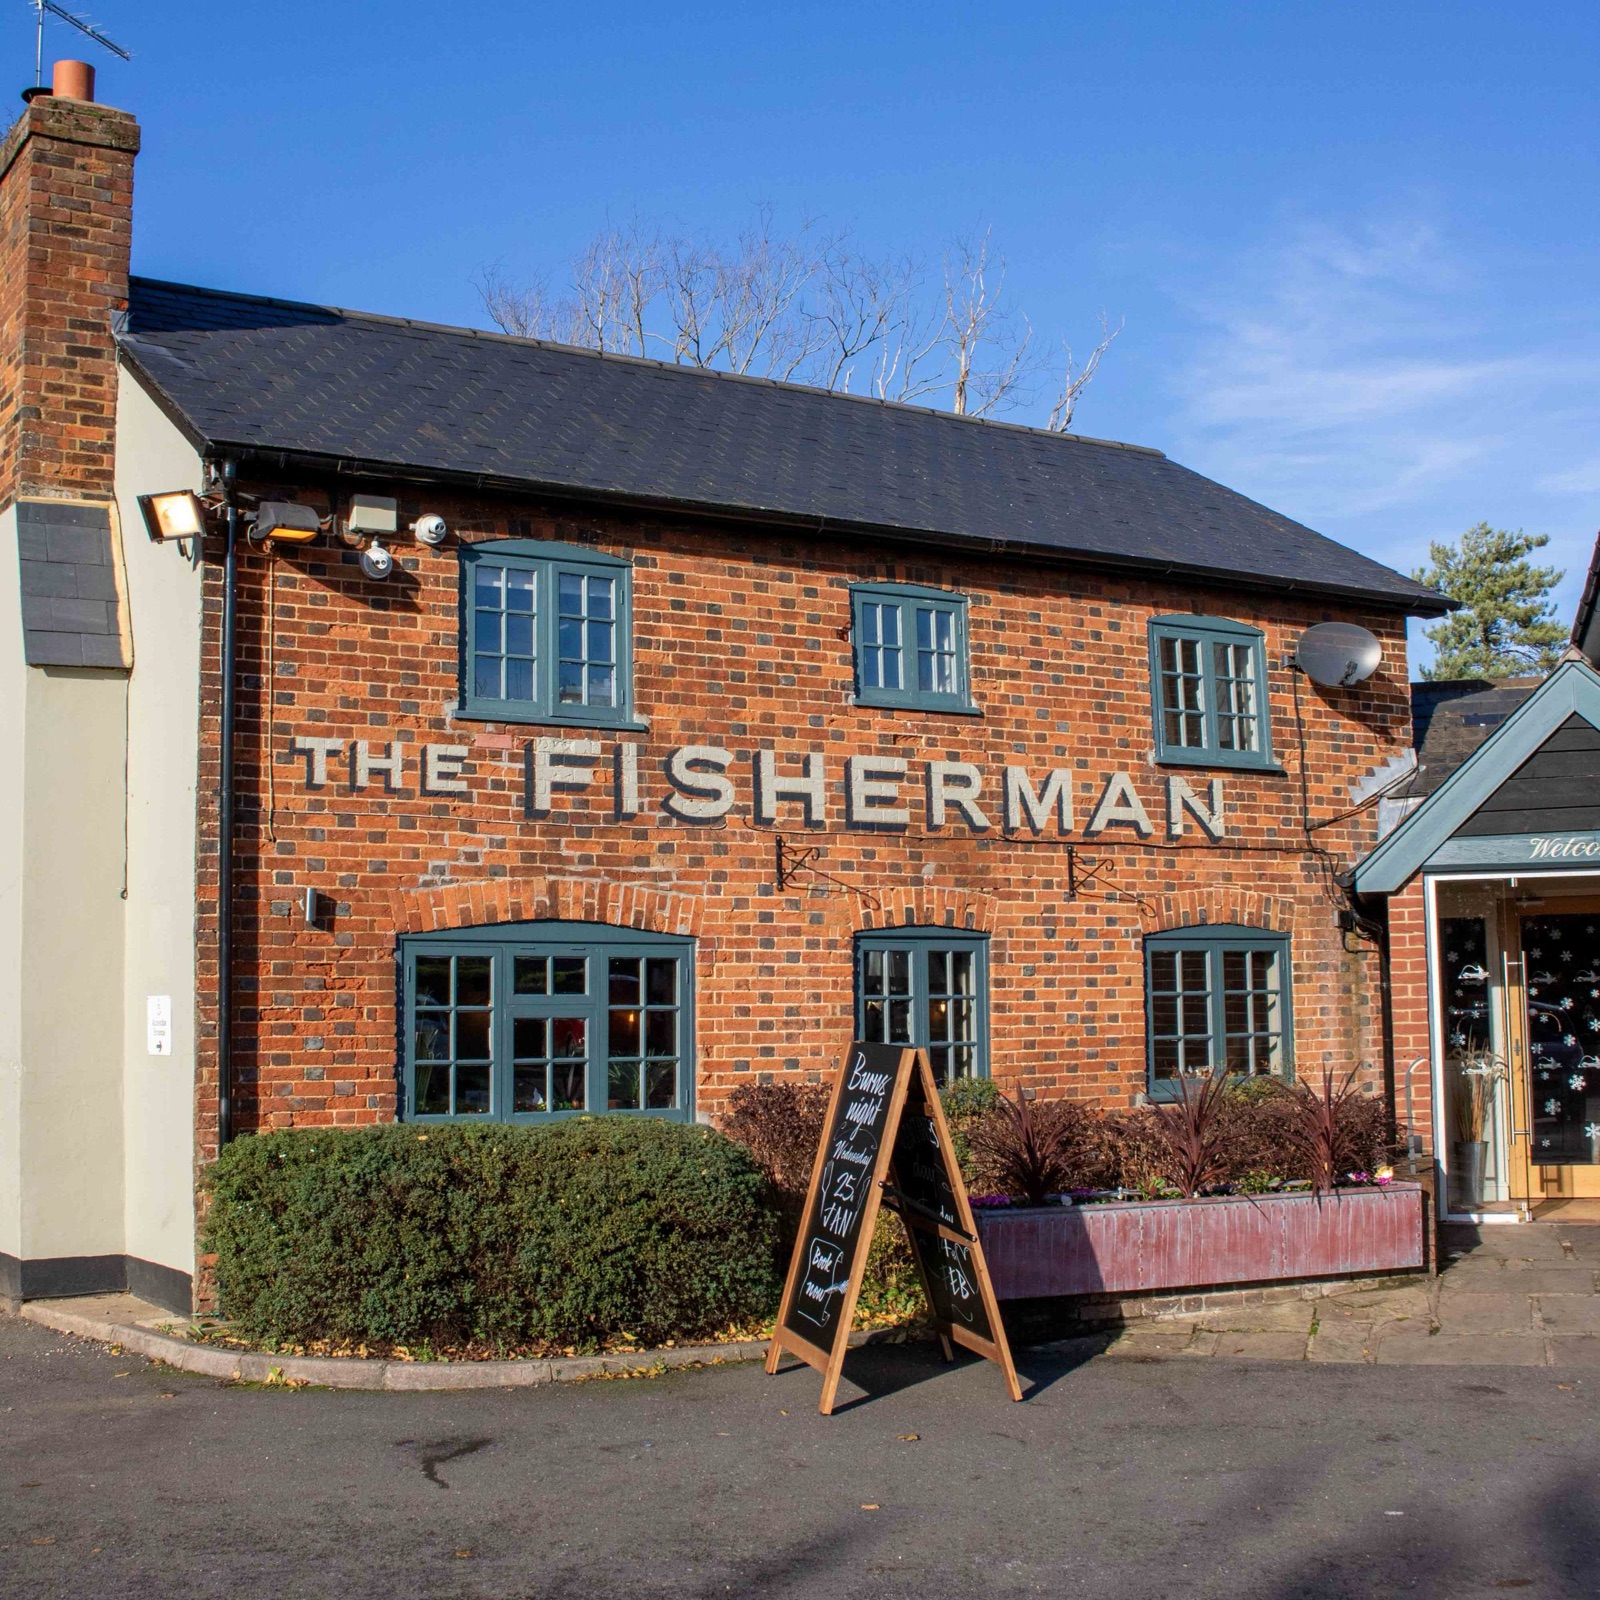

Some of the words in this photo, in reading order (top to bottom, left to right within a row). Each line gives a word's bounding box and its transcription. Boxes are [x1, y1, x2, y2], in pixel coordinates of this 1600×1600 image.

[289, 736, 470, 798] THE
[524, 736, 1225, 844] FISHERMAN
[847, 1051, 893, 1096] Burns
[845, 1096, 883, 1141] night
[832, 1140, 873, 1188] Wednesday
[823, 1202, 853, 1238] JAN
[812, 1246, 833, 1273] Book
[805, 1281, 826, 1302] now
